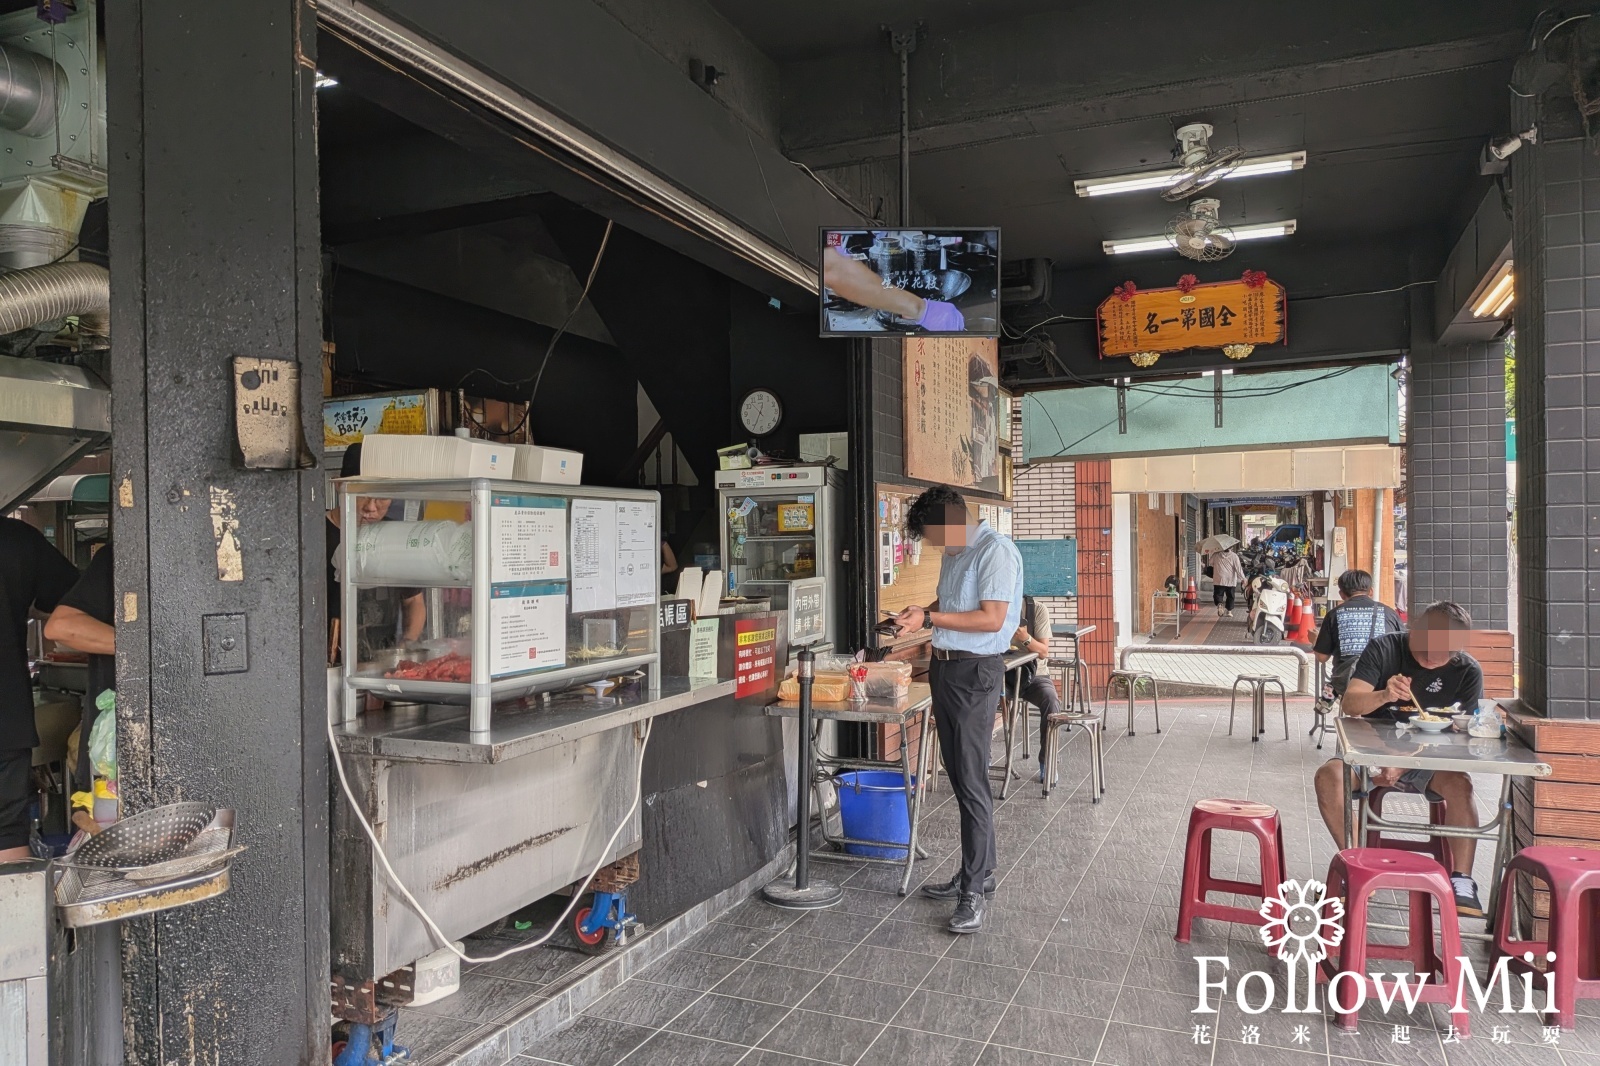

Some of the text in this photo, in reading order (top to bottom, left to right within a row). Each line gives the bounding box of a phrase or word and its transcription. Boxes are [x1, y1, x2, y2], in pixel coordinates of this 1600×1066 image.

[881, 275, 939, 291] 生炒花枝
[1142, 304, 1237, 334] 全國第一名
[795, 594, 820, 611] 內用外帶
